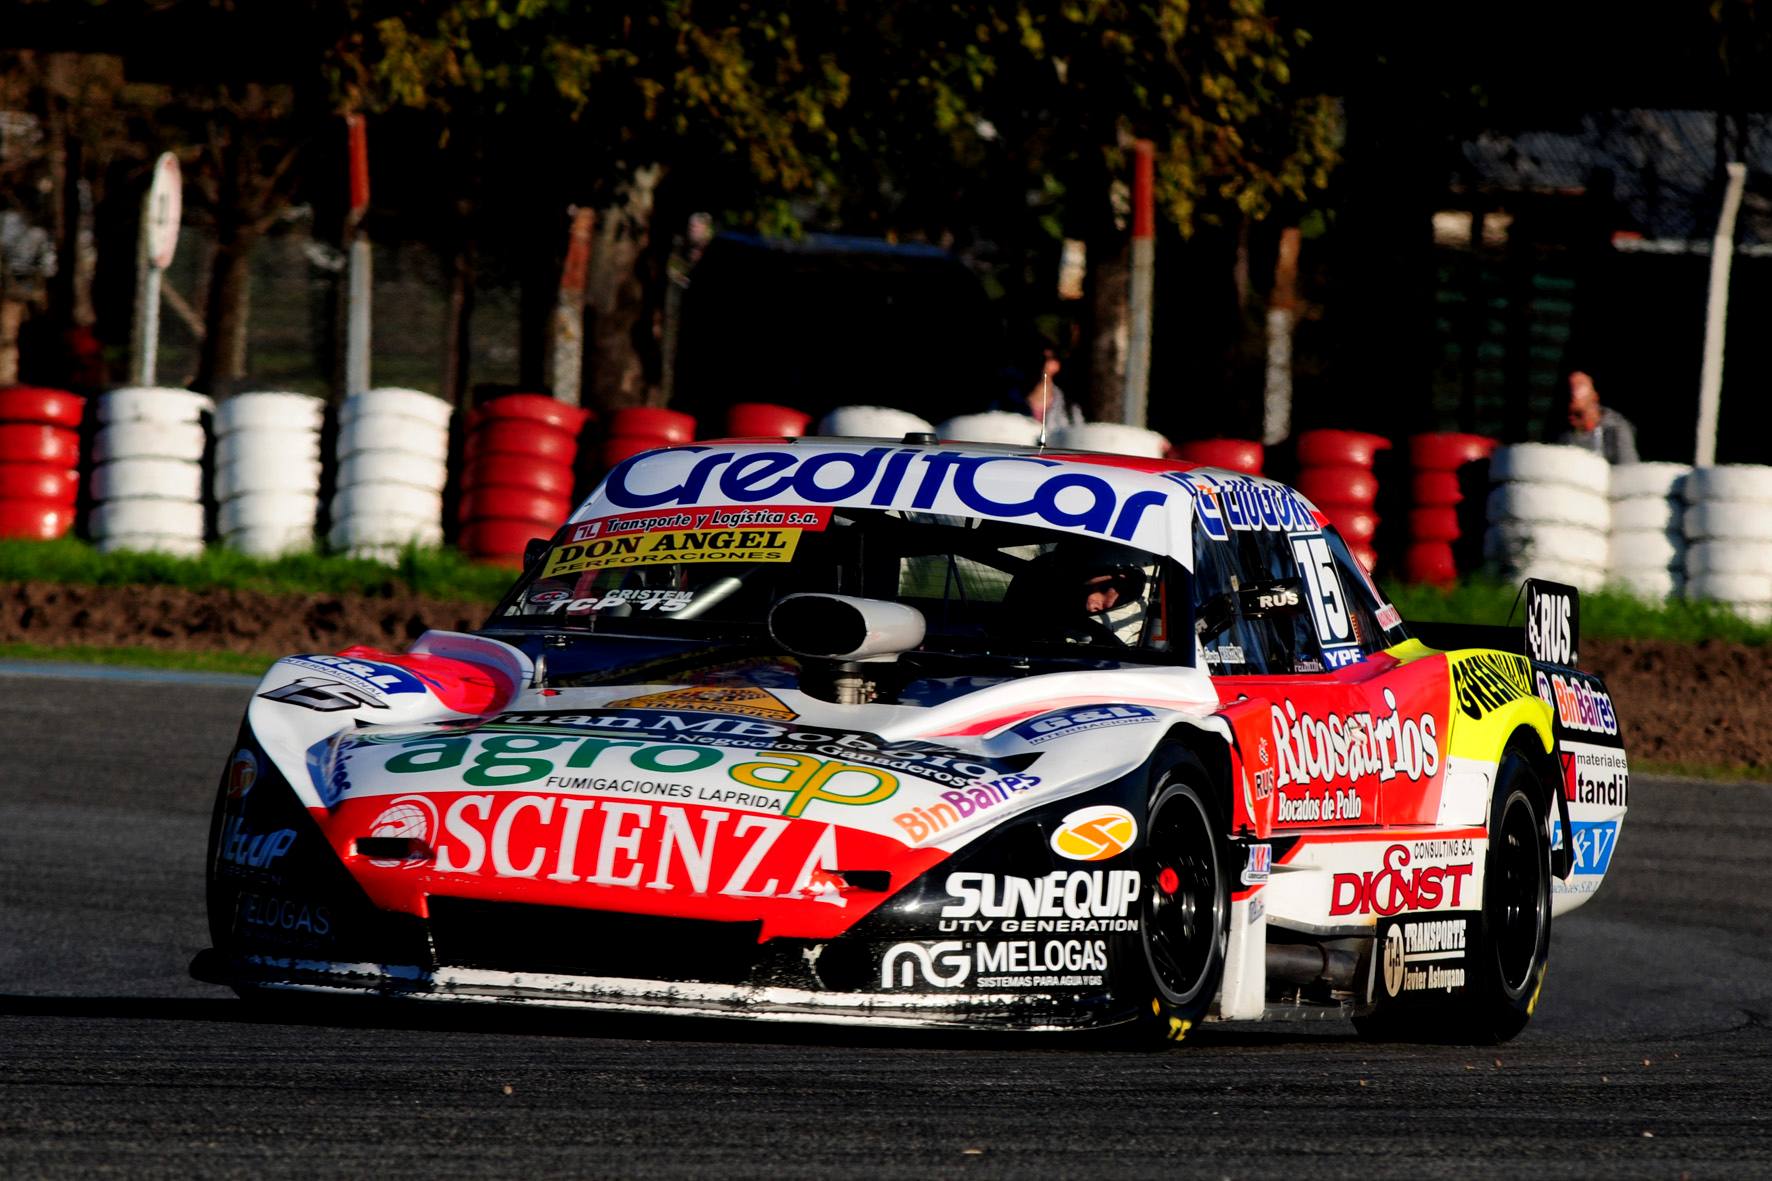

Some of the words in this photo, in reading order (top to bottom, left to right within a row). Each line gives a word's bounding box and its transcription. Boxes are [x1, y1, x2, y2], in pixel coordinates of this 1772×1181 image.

[605, 447, 1168, 541] CreditCar
[607, 514, 691, 533] Transporte
[696, 514, 707, 529] y
[711, 510, 783, 525] Logística
[551, 551, 781, 574] PERFORACIONES
[554, 536, 645, 565] DON
[650, 531, 788, 552] ANGEL
[1260, 592, 1299, 608] RUS
[1292, 538, 1349, 641] 15
[1540, 593, 1571, 665] RUS
[1323, 650, 1363, 668] YPF
[1030, 706, 1142, 733] G&L
[1030, 716, 1157, 744] INTERNACIONAL
[1270, 687, 1440, 788] Ricosaurios
[671, 734, 808, 752] Negocios
[817, 744, 979, 788] Ganaderos
[1577, 754, 1627, 768] materiales
[546, 775, 694, 798] FUMIGACIONES
[698, 786, 784, 811] LAPRIDA
[1278, 790, 1320, 821] Bocados
[1321, 790, 1335, 820] de
[1335, 788, 1362, 819] Pollo
[1578, 772, 1629, 806] tandil
[432, 794, 848, 906] SCIENZA
[1414, 841, 1459, 859] CONSULTING
[938, 920, 993, 932] UTV
[1001, 919, 1139, 932] GENERATION
[1404, 919, 1467, 952] TRANSPORTE
[976, 940, 1108, 972] MELOGAS
[976, 977, 1033, 988] SISTEMAS
[1403, 966, 1426, 991] Javier
[1428, 965, 1465, 993] Astorgano
